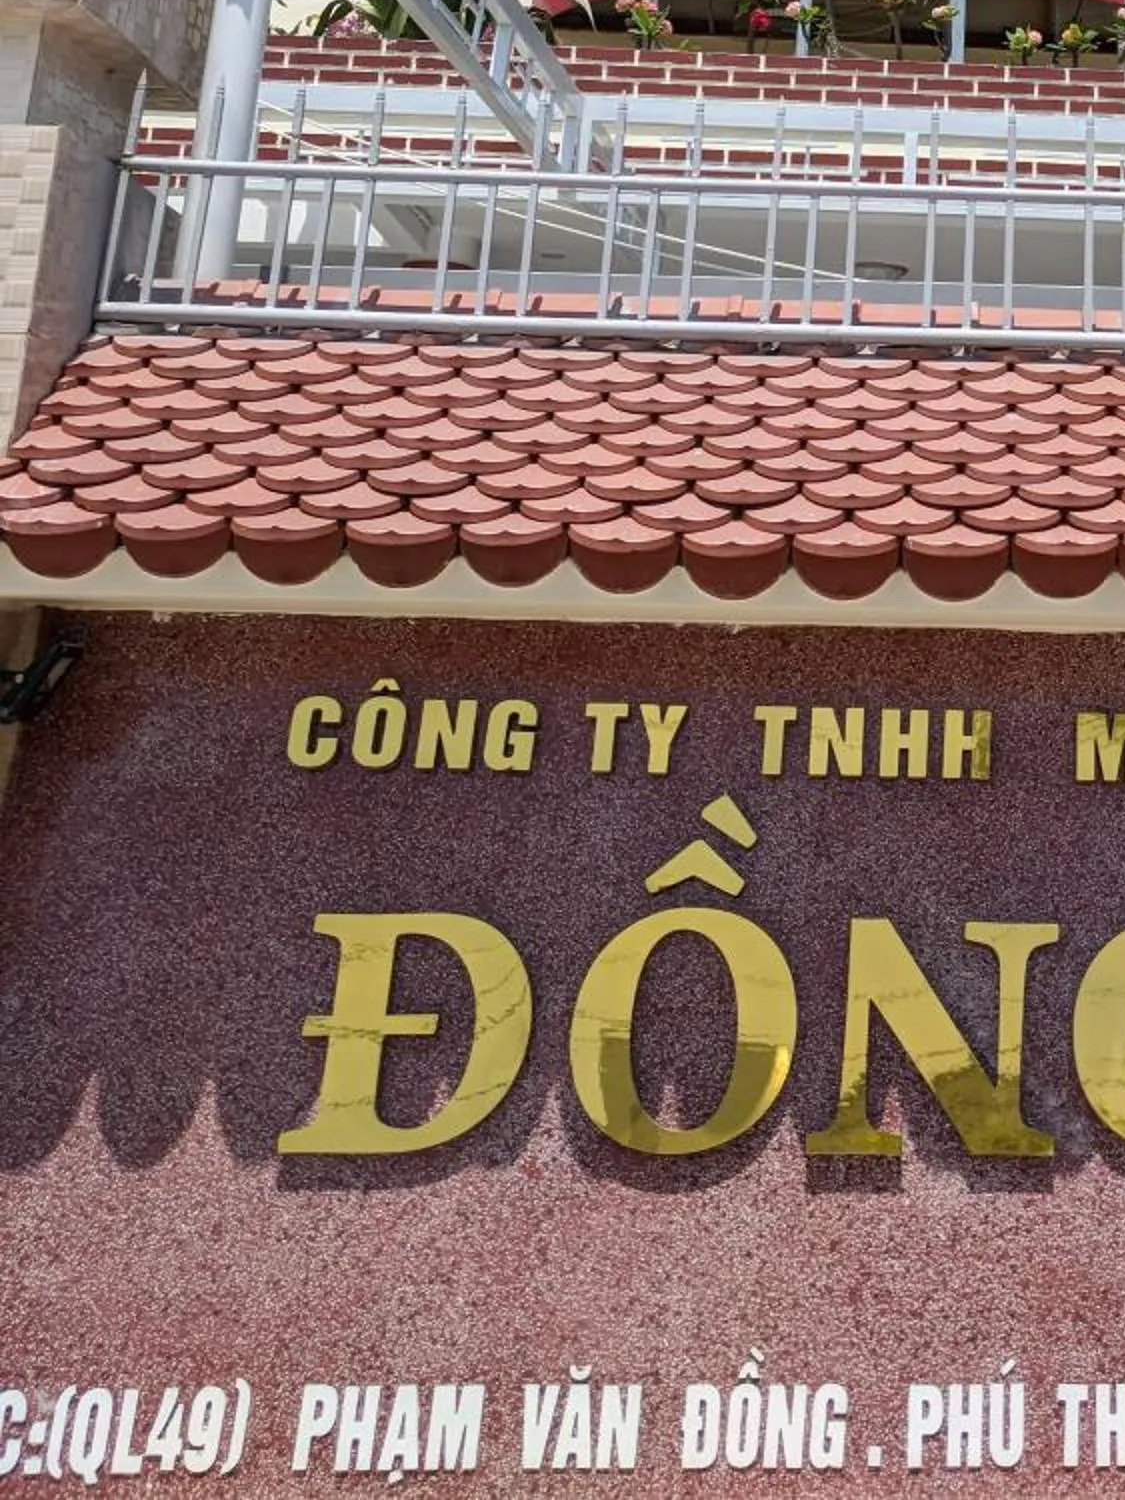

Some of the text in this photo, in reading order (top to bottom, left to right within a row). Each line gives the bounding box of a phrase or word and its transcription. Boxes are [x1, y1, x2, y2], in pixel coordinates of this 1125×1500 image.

[286, 678, 538, 774] CÔNG
[585, 704, 688, 775] TY
[753, 707, 993, 781] TNHH
[292, 1384, 486, 1484] PHẠM
[520, 1364, 642, 1472] VĂN
[681, 1346, 849, 1470] ĐỒNG
[906, 1359, 1025, 1469] PHÚ
